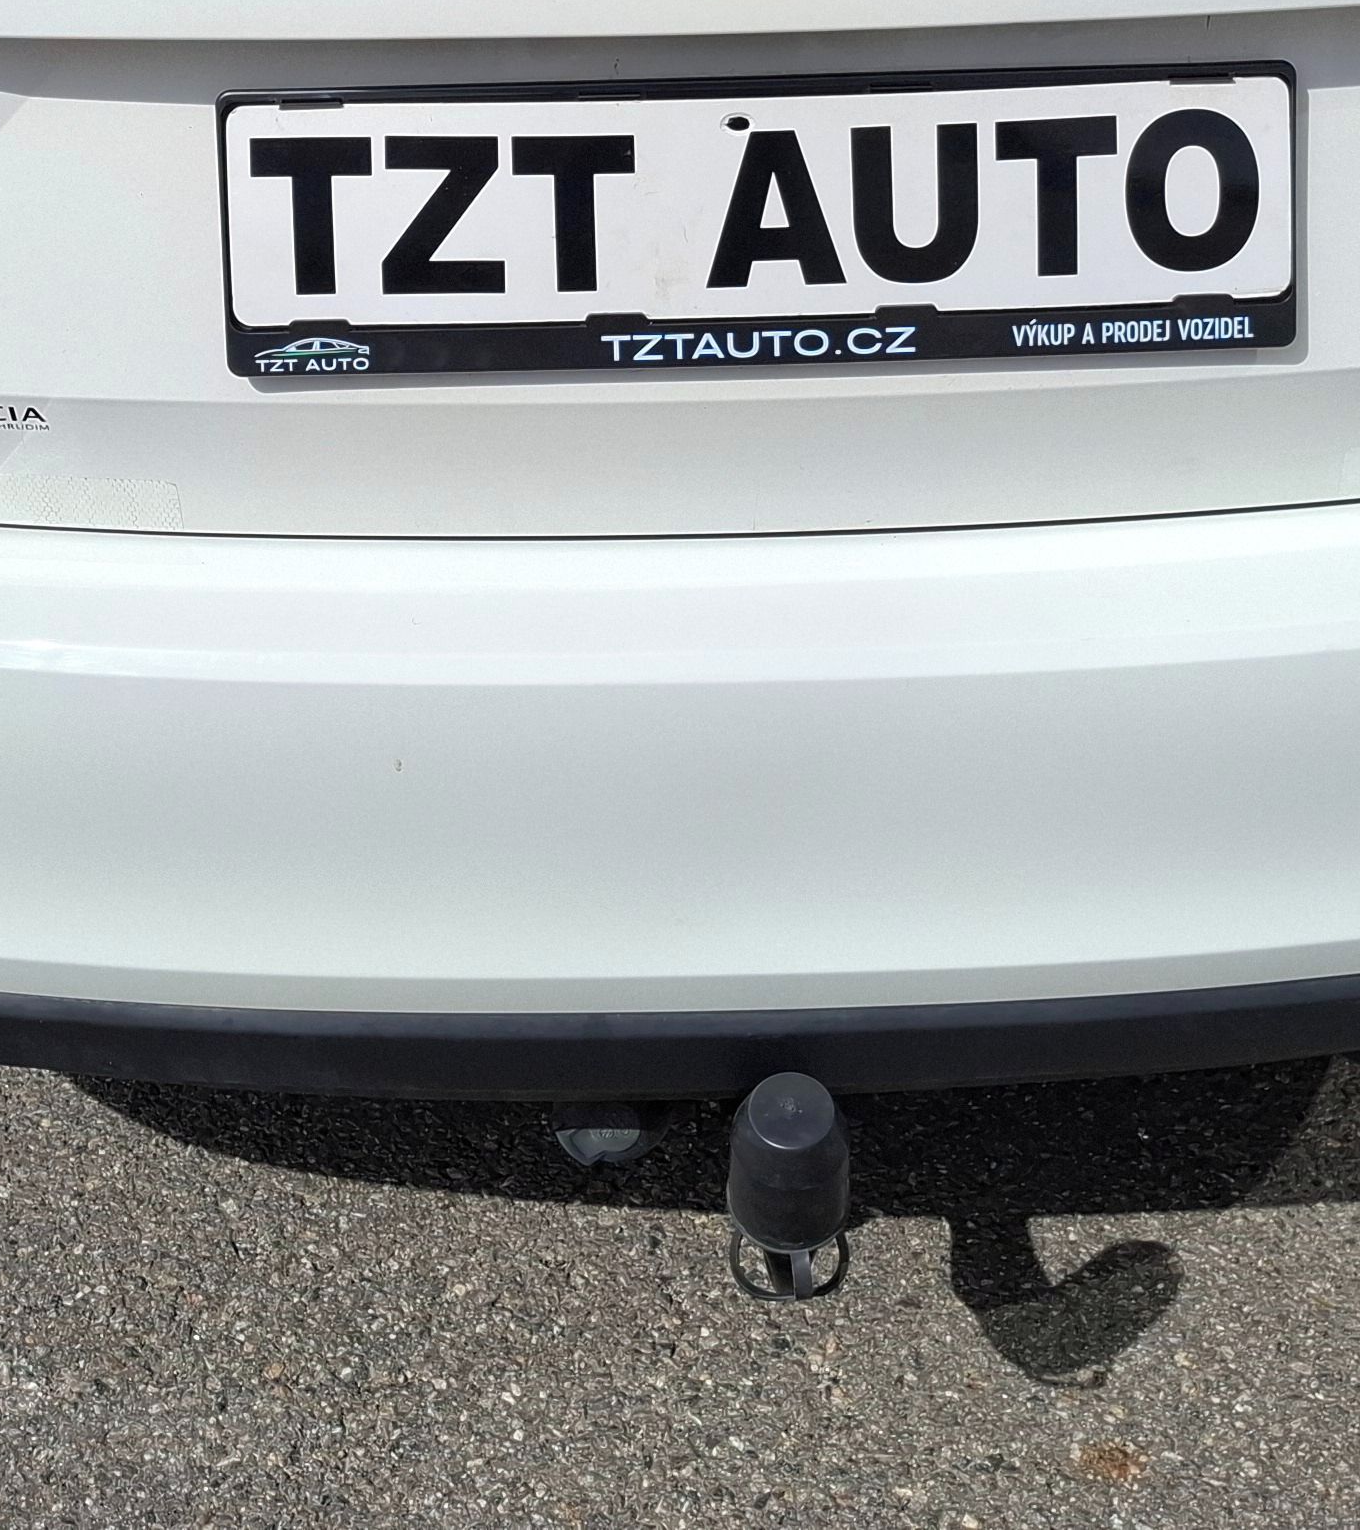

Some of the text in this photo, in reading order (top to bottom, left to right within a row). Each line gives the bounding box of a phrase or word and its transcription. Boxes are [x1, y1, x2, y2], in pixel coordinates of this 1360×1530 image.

[249, 108, 1260, 295] TZT AUTO
[601, 326, 916, 361] TZTAUTO.CZ
[1012, 316, 1254, 347] VÝKUP A PRODEJ VOZIDEL
[255, 357, 370, 372] TZT AUTO
